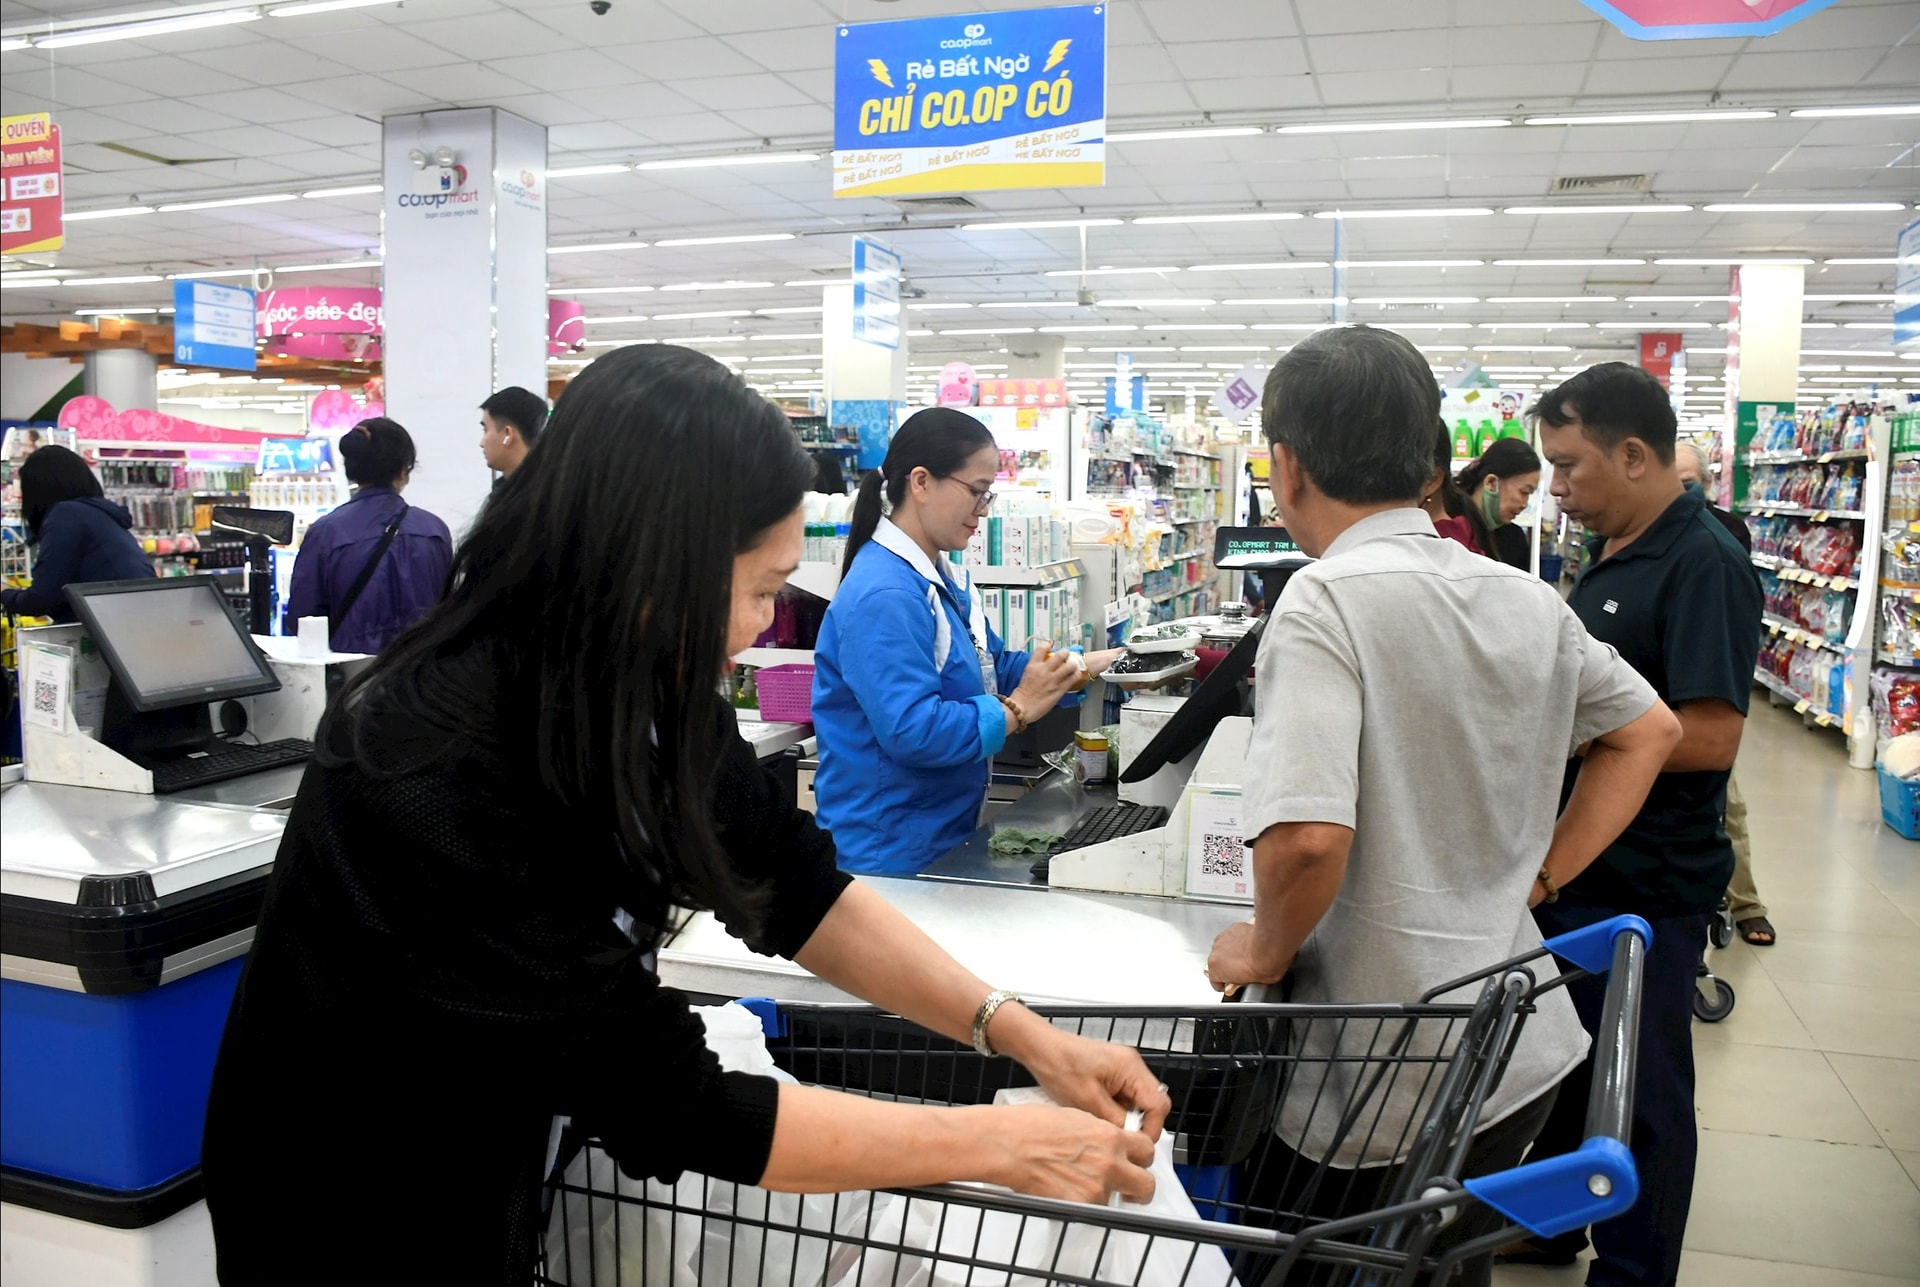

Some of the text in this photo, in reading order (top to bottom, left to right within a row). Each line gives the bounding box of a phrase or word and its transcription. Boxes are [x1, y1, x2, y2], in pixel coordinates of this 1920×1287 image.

[906, 53, 1031, 80] Rẻ Bất Ngờ
[858, 70, 1073, 136] CHỈ CO.OP CÓ
[1032, 132, 1053, 146] BẤT
[943, 150, 964, 163] BẤT
[858, 167, 878, 181] BẤT
[178, 345, 192, 361] 01
